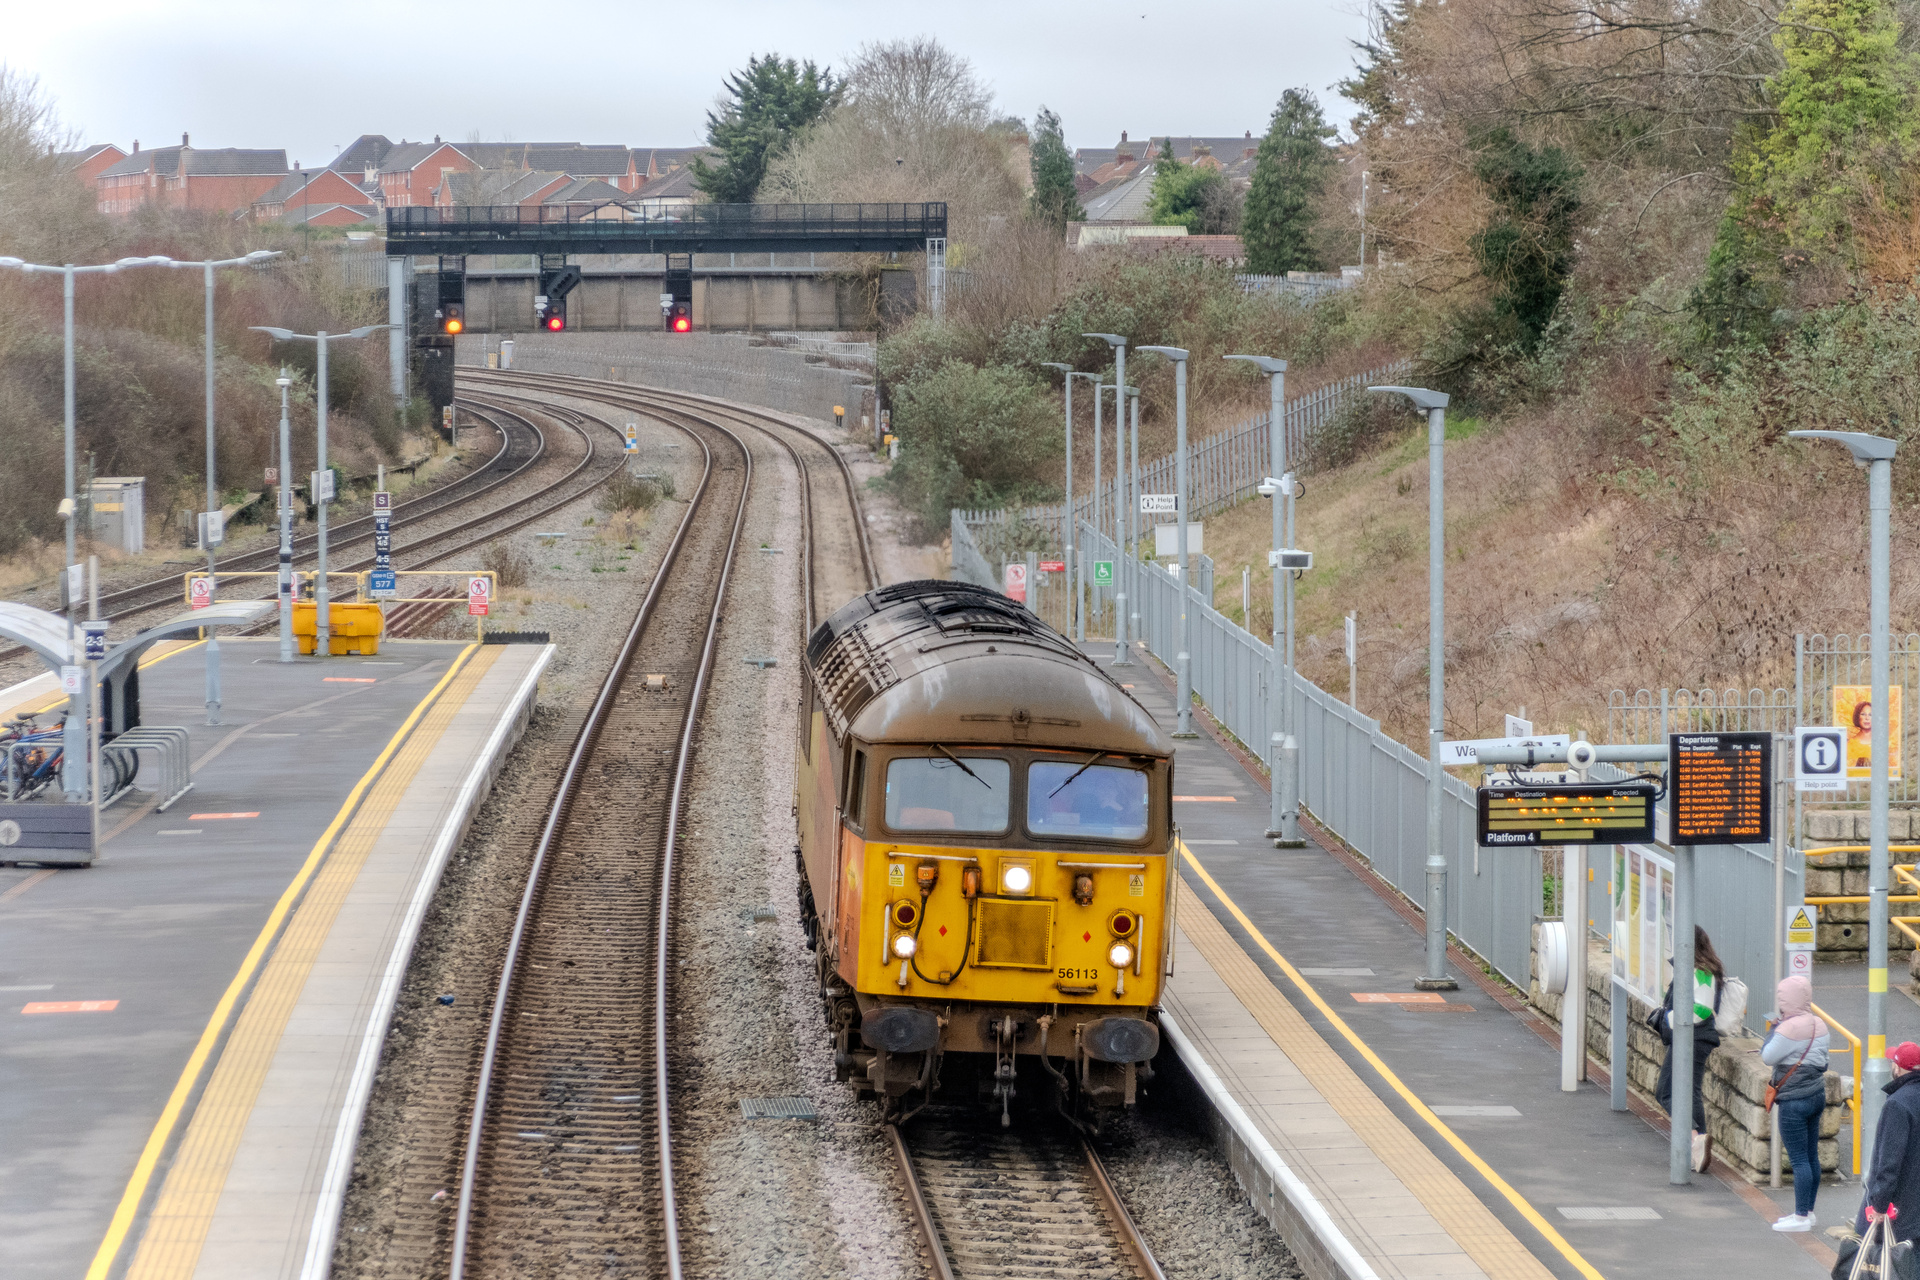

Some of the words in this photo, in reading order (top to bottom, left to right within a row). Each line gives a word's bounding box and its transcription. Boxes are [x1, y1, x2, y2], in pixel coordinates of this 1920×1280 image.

[378, 496, 385, 504] S
[376, 554, 390, 562] 4-5
[86, 636, 104, 646] 2-3
[1680, 736, 1718, 744] Departures
[1487, 832, 1527, 842] Platform
[1528, 832, 1534, 841] 4
[1058, 968, 1098, 979] 56113
